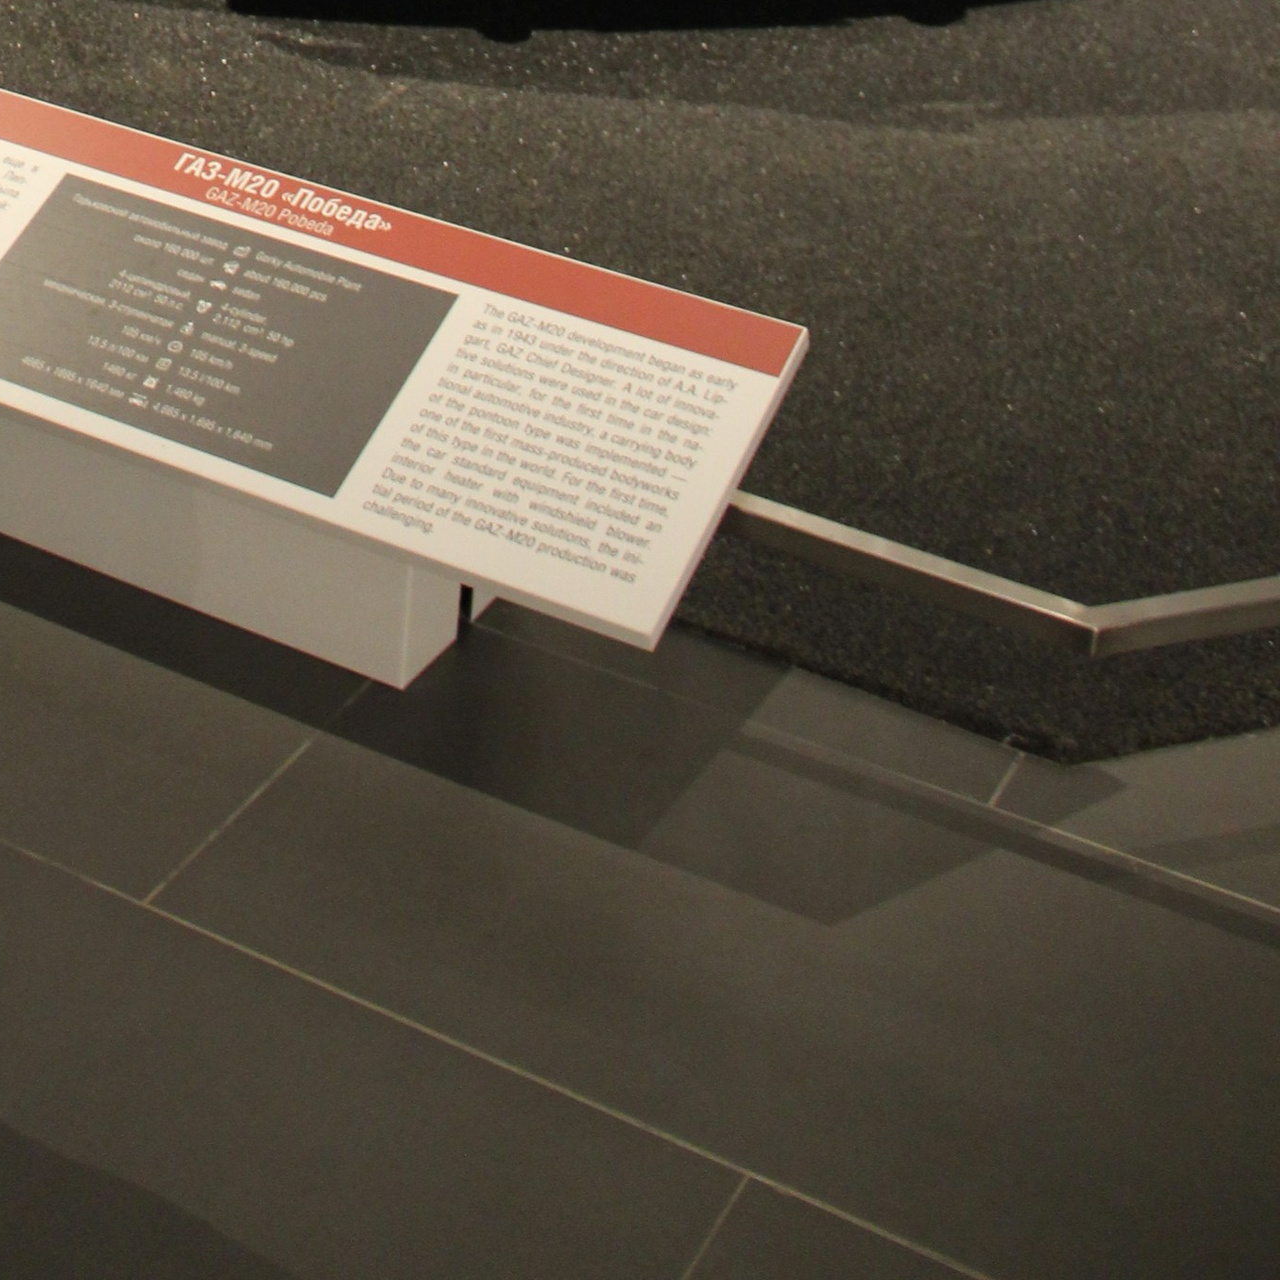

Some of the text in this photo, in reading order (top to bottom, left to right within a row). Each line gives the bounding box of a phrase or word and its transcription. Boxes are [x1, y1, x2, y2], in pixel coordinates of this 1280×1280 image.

[173, 152, 391, 231] ГАЗ-М20 «Победа»
[204, 186, 334, 236] GAZ-M20 Pobeda
[454, 347, 478, 362] tive
[479, 356, 535, 381] solutions
[538, 375, 568, 391] were
[570, 385, 603, 402] used
[603, 395, 617, 405] in
[619, 399, 640, 414] the
[642, 408, 663, 421] car
[471, 319, 488, 331] as
[489, 325, 503, 335] in
[506, 328, 538, 345] 1943
[538, 340, 574, 357] under
[576, 350, 597, 364] the
[599, 358, 654, 383] direction
[656, 376, 672, 387] of
[482, 302, 738, 391] The GAZ-M20 development began as early
[495, 342, 524, 359] GAZ
[525, 351, 559, 369] Chief
[621, 381, 632, 393] A
[634, 386, 654, 400] lot
[655, 393, 672, 405] of
[427, 392, 668, 478] of the pontoon type was implemented
[436, 376, 472, 396] tional
[472, 389, 541, 418] automotive
[598, 430, 608, 440] a
[609, 433, 662, 460] carrying
[663, 449, 697, 470] body
[445, 362, 459, 374] in
[527, 387, 547, 402] for
[550, 395, 572, 410] the
[575, 402, 603, 420] first
[605, 413, 635, 430] time
[639, 424, 652, 435] in
[656, 428, 678, 444] the
[390, 452, 435, 475] interior
[443, 469, 483, 491] heater
[491, 488, 519, 504] with
[528, 500, 598, 531] windshield
[399, 436, 663, 533] the car standard equipment included an
[409, 423, 426, 434] of
[424, 426, 449, 443] this
[450, 435, 479, 453] type
[481, 446, 494, 457] in
[495, 450, 517, 465] the
[560, 471, 582, 487] For
[584, 480, 606, 495] the
[608, 487, 636, 505] first
[418, 408, 680, 501] one of the first mass-produced bodyworks
[371, 483, 637, 584] tial period of the GAZ-M20 production was
[380, 466, 407, 485] Due
[408, 477, 423, 490] to
[425, 484, 461, 504] many
[464, 497, 528, 527] innovative
[596, 541, 619, 557] the
